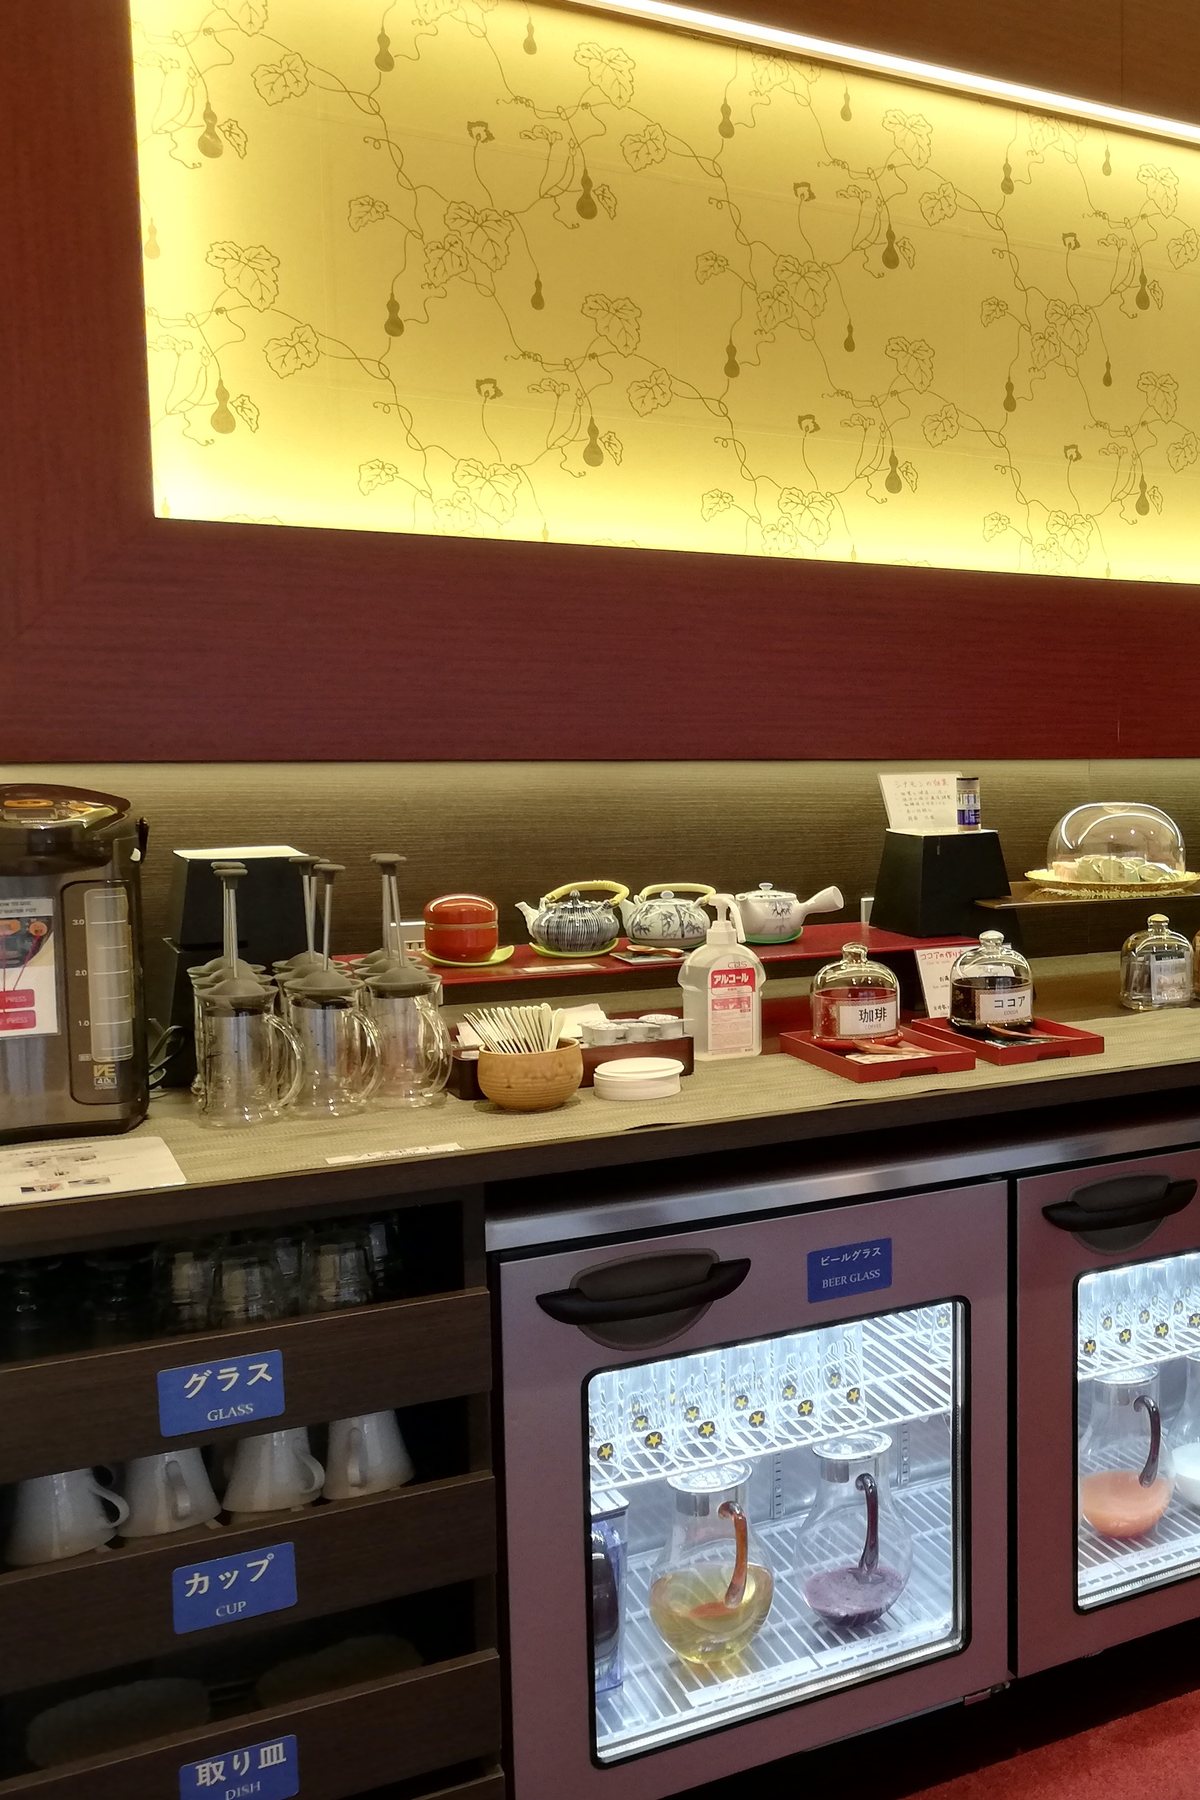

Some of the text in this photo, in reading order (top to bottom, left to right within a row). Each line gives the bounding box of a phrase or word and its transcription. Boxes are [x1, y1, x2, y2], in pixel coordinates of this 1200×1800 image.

[72, 918, 85, 926] 3.0
[713, 972, 750, 985] アルコール
[994, 995, 1026, 1008] ココア
[859, 1006, 888, 1023] 珈琲
[821, 1247, 882, 1267] ビールグラス
[822, 1268, 881, 1289] BEER GLASS
[183, 1362, 273, 1399] グラス
[207, 1402, 254, 1422] GLASS
[184, 1552, 275, 1598] カップ
[215, 1600, 247, 1617] CUP
[195, 1742, 287, 1787] 取り皿
[225, 1780, 261, 1800] DISH
